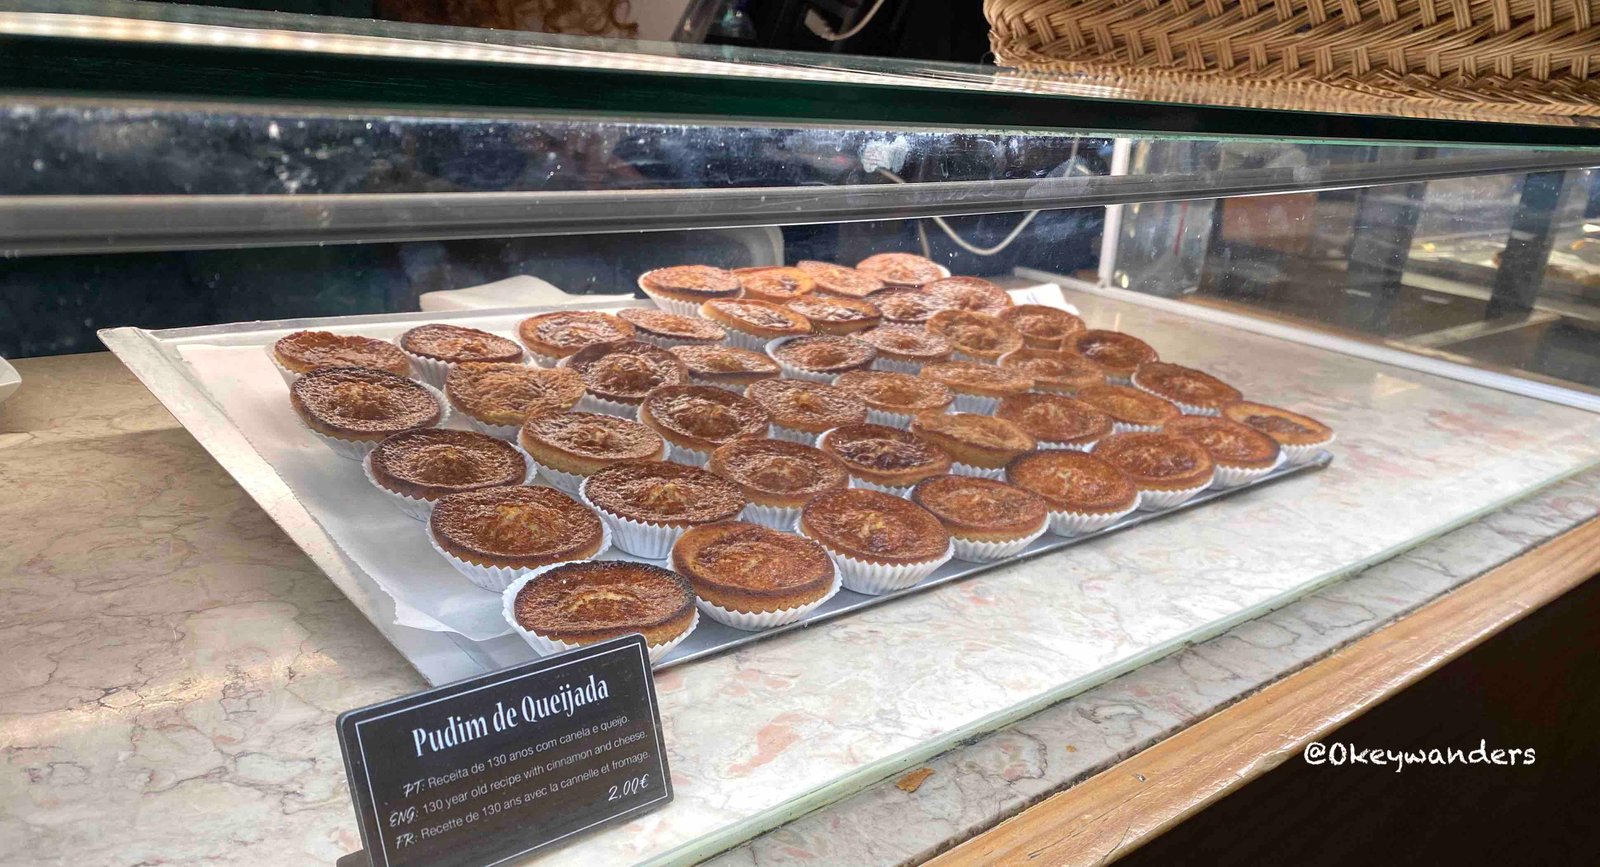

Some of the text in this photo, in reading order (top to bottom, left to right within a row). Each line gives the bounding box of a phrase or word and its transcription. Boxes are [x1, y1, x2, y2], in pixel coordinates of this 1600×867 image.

[411, 675, 609, 757] Pudim de Queijada
[428, 767, 469, 789] Receita
[471, 762, 486, 775] de
[488, 754, 507, 769] 130
[509, 746, 534, 761] anos
[536, 739, 557, 753] com
[560, 728, 591, 745] canela
[593, 725, 599, 734] e
[601, 715, 630, 732] queijo.
[421, 816, 463, 840] Recette
[465, 811, 479, 823] de
[482, 802, 501, 817] 130
[503, 796, 522, 810] ans
[525, 787, 548, 803] avec
[550, 781, 559, 792] la
[560, 767, 600, 789] cannelle
[601, 765, 610, 775] et
[423, 799, 444, 814] 130
[445, 792, 469, 809] year
[471, 784, 488, 798] old
[490, 774, 522, 791] recipe
[523, 765, 544, 780] with
[546, 749, 593, 772] cinnamon
[594, 741, 612, 755] and
[614, 731, 648, 748] cheese.
